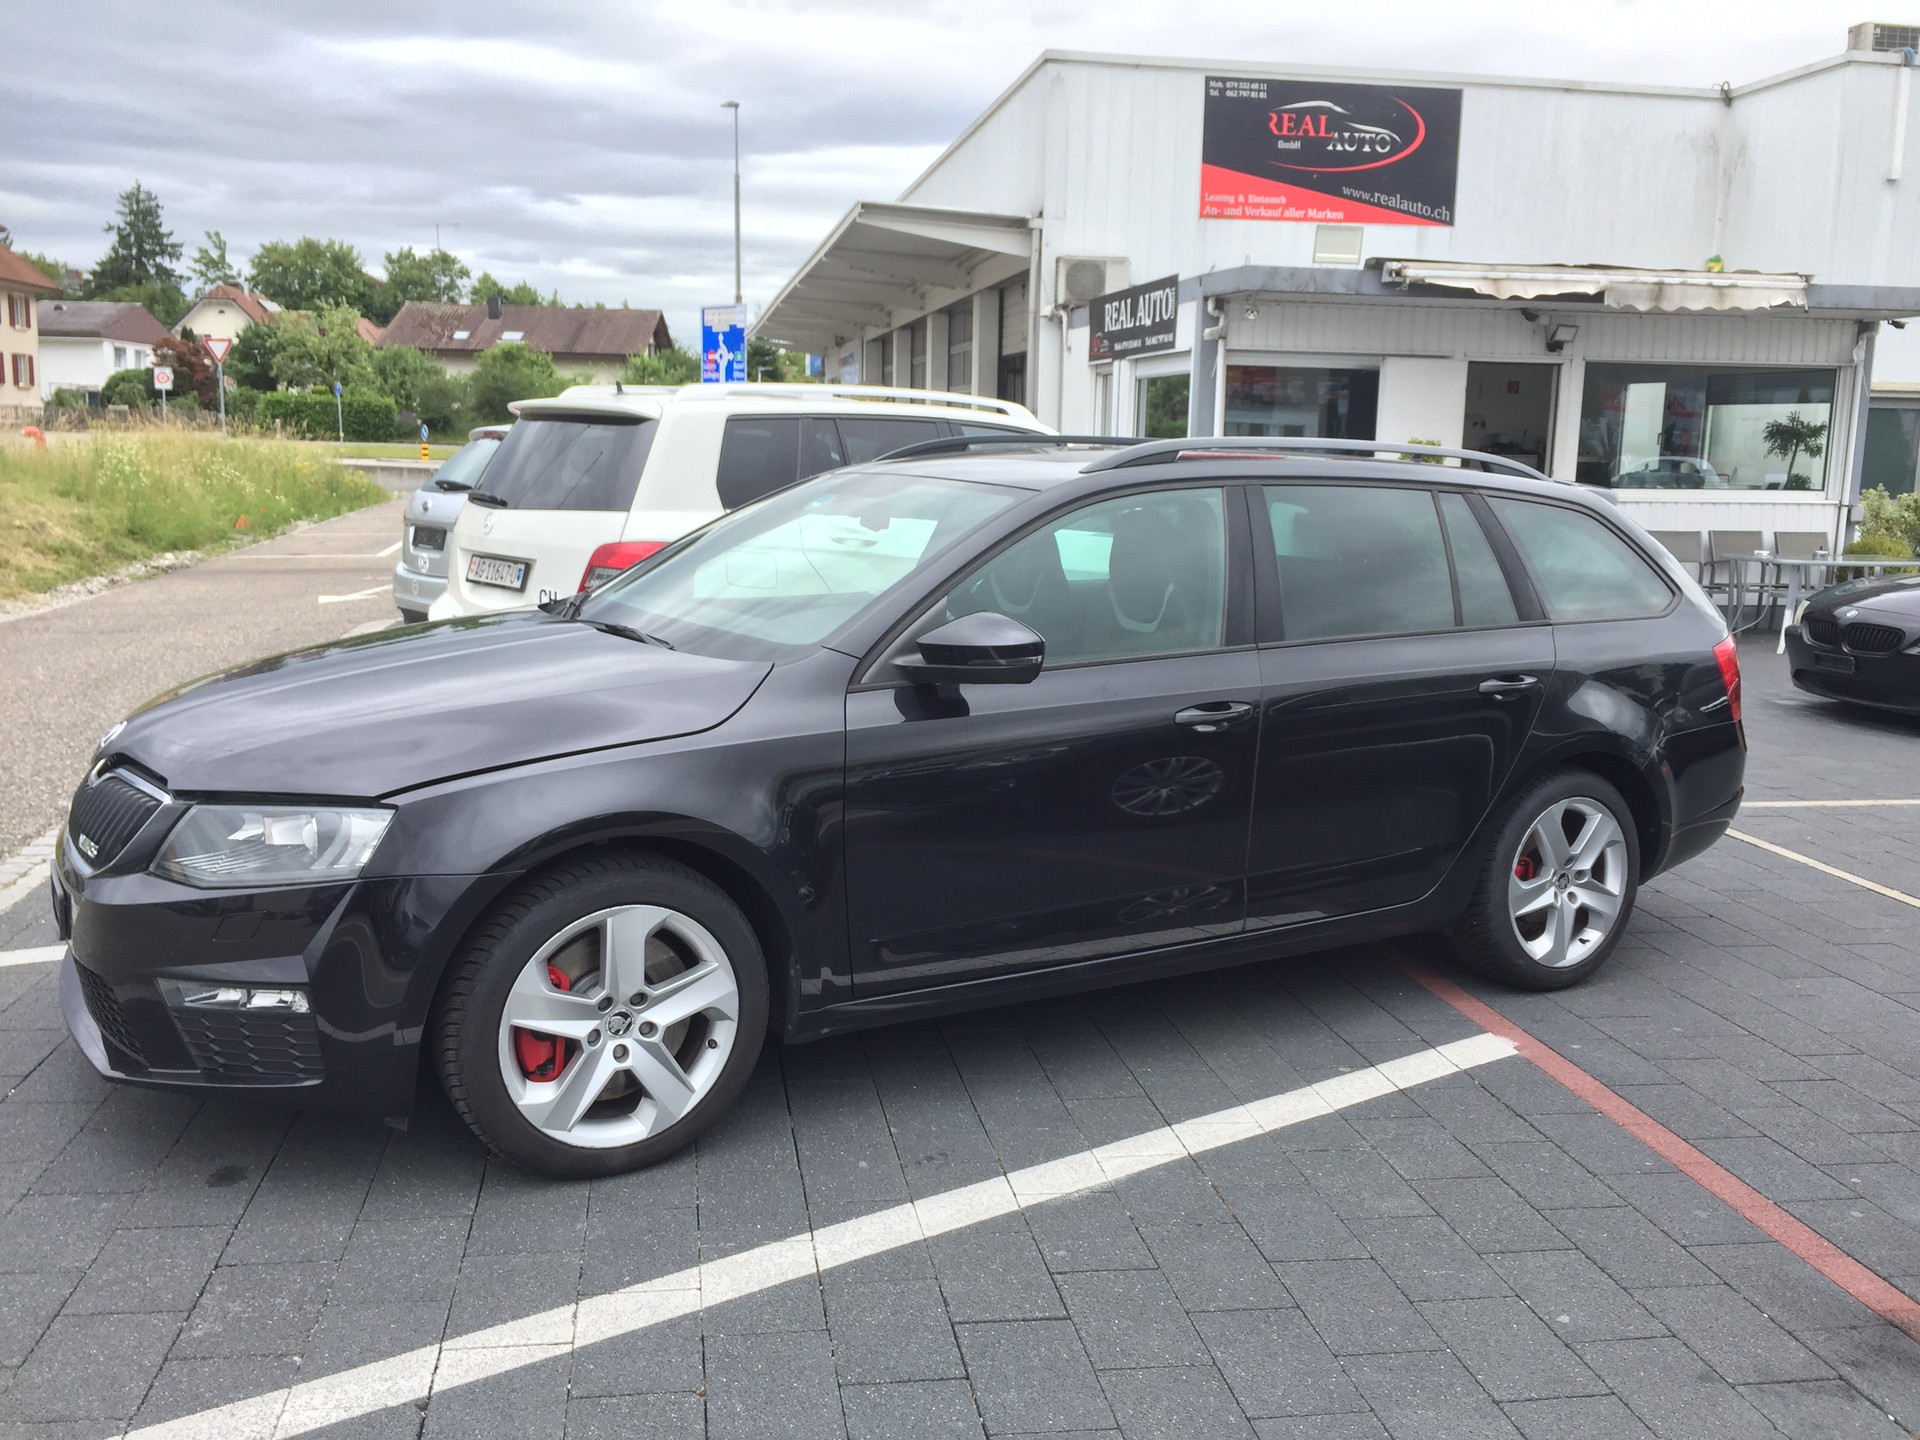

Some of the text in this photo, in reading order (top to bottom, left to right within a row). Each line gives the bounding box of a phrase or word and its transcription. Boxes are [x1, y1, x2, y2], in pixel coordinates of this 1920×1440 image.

[1268, 112, 1335, 138] REAL
[1277, 139, 1302, 150] GmbH
[1326, 131, 1392, 153] AUTO
[1204, 205, 1344, 219] An- und Verkauf aller Marken
[1342, 186, 1450, 221] www.realauto.ch
[1104, 297, 1135, 333] REAL
[1135, 287, 1172, 327] AUTO
